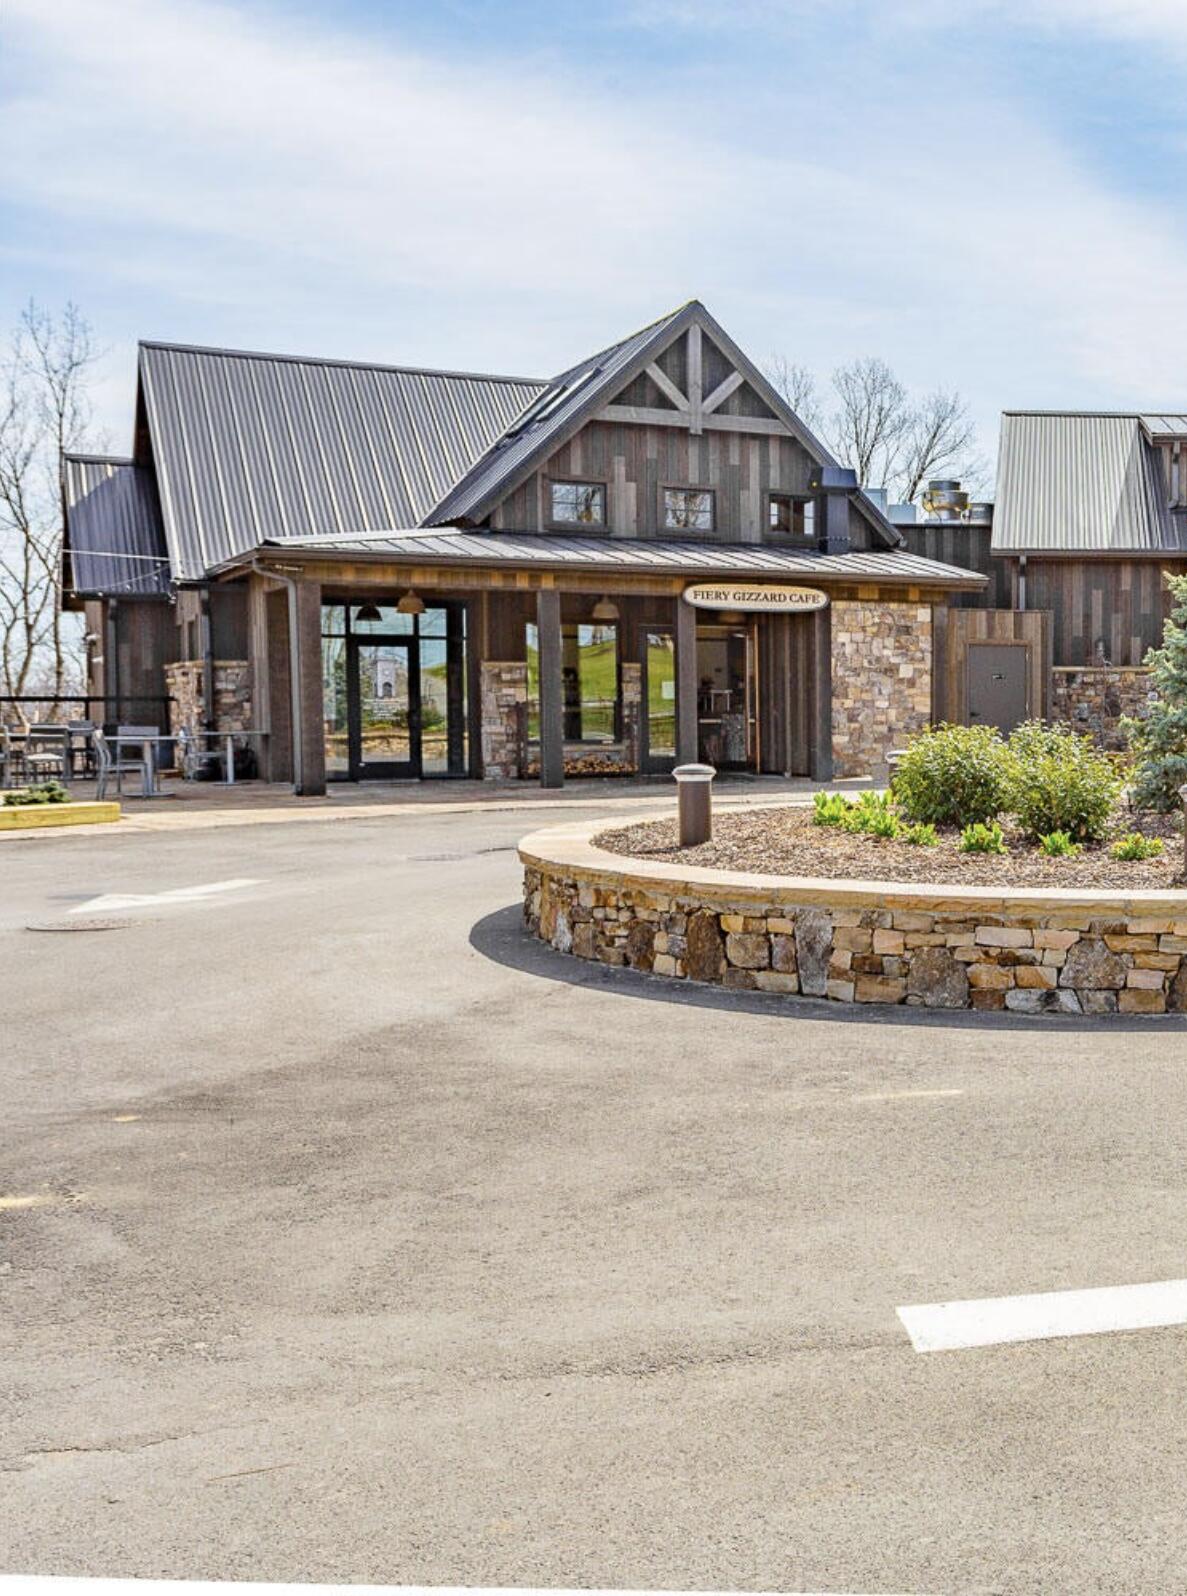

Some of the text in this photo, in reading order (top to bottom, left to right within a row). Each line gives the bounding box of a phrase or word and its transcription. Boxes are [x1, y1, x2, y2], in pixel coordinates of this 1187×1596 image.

[693, 590, 820, 603] FIERY GIZZARD CAFE
